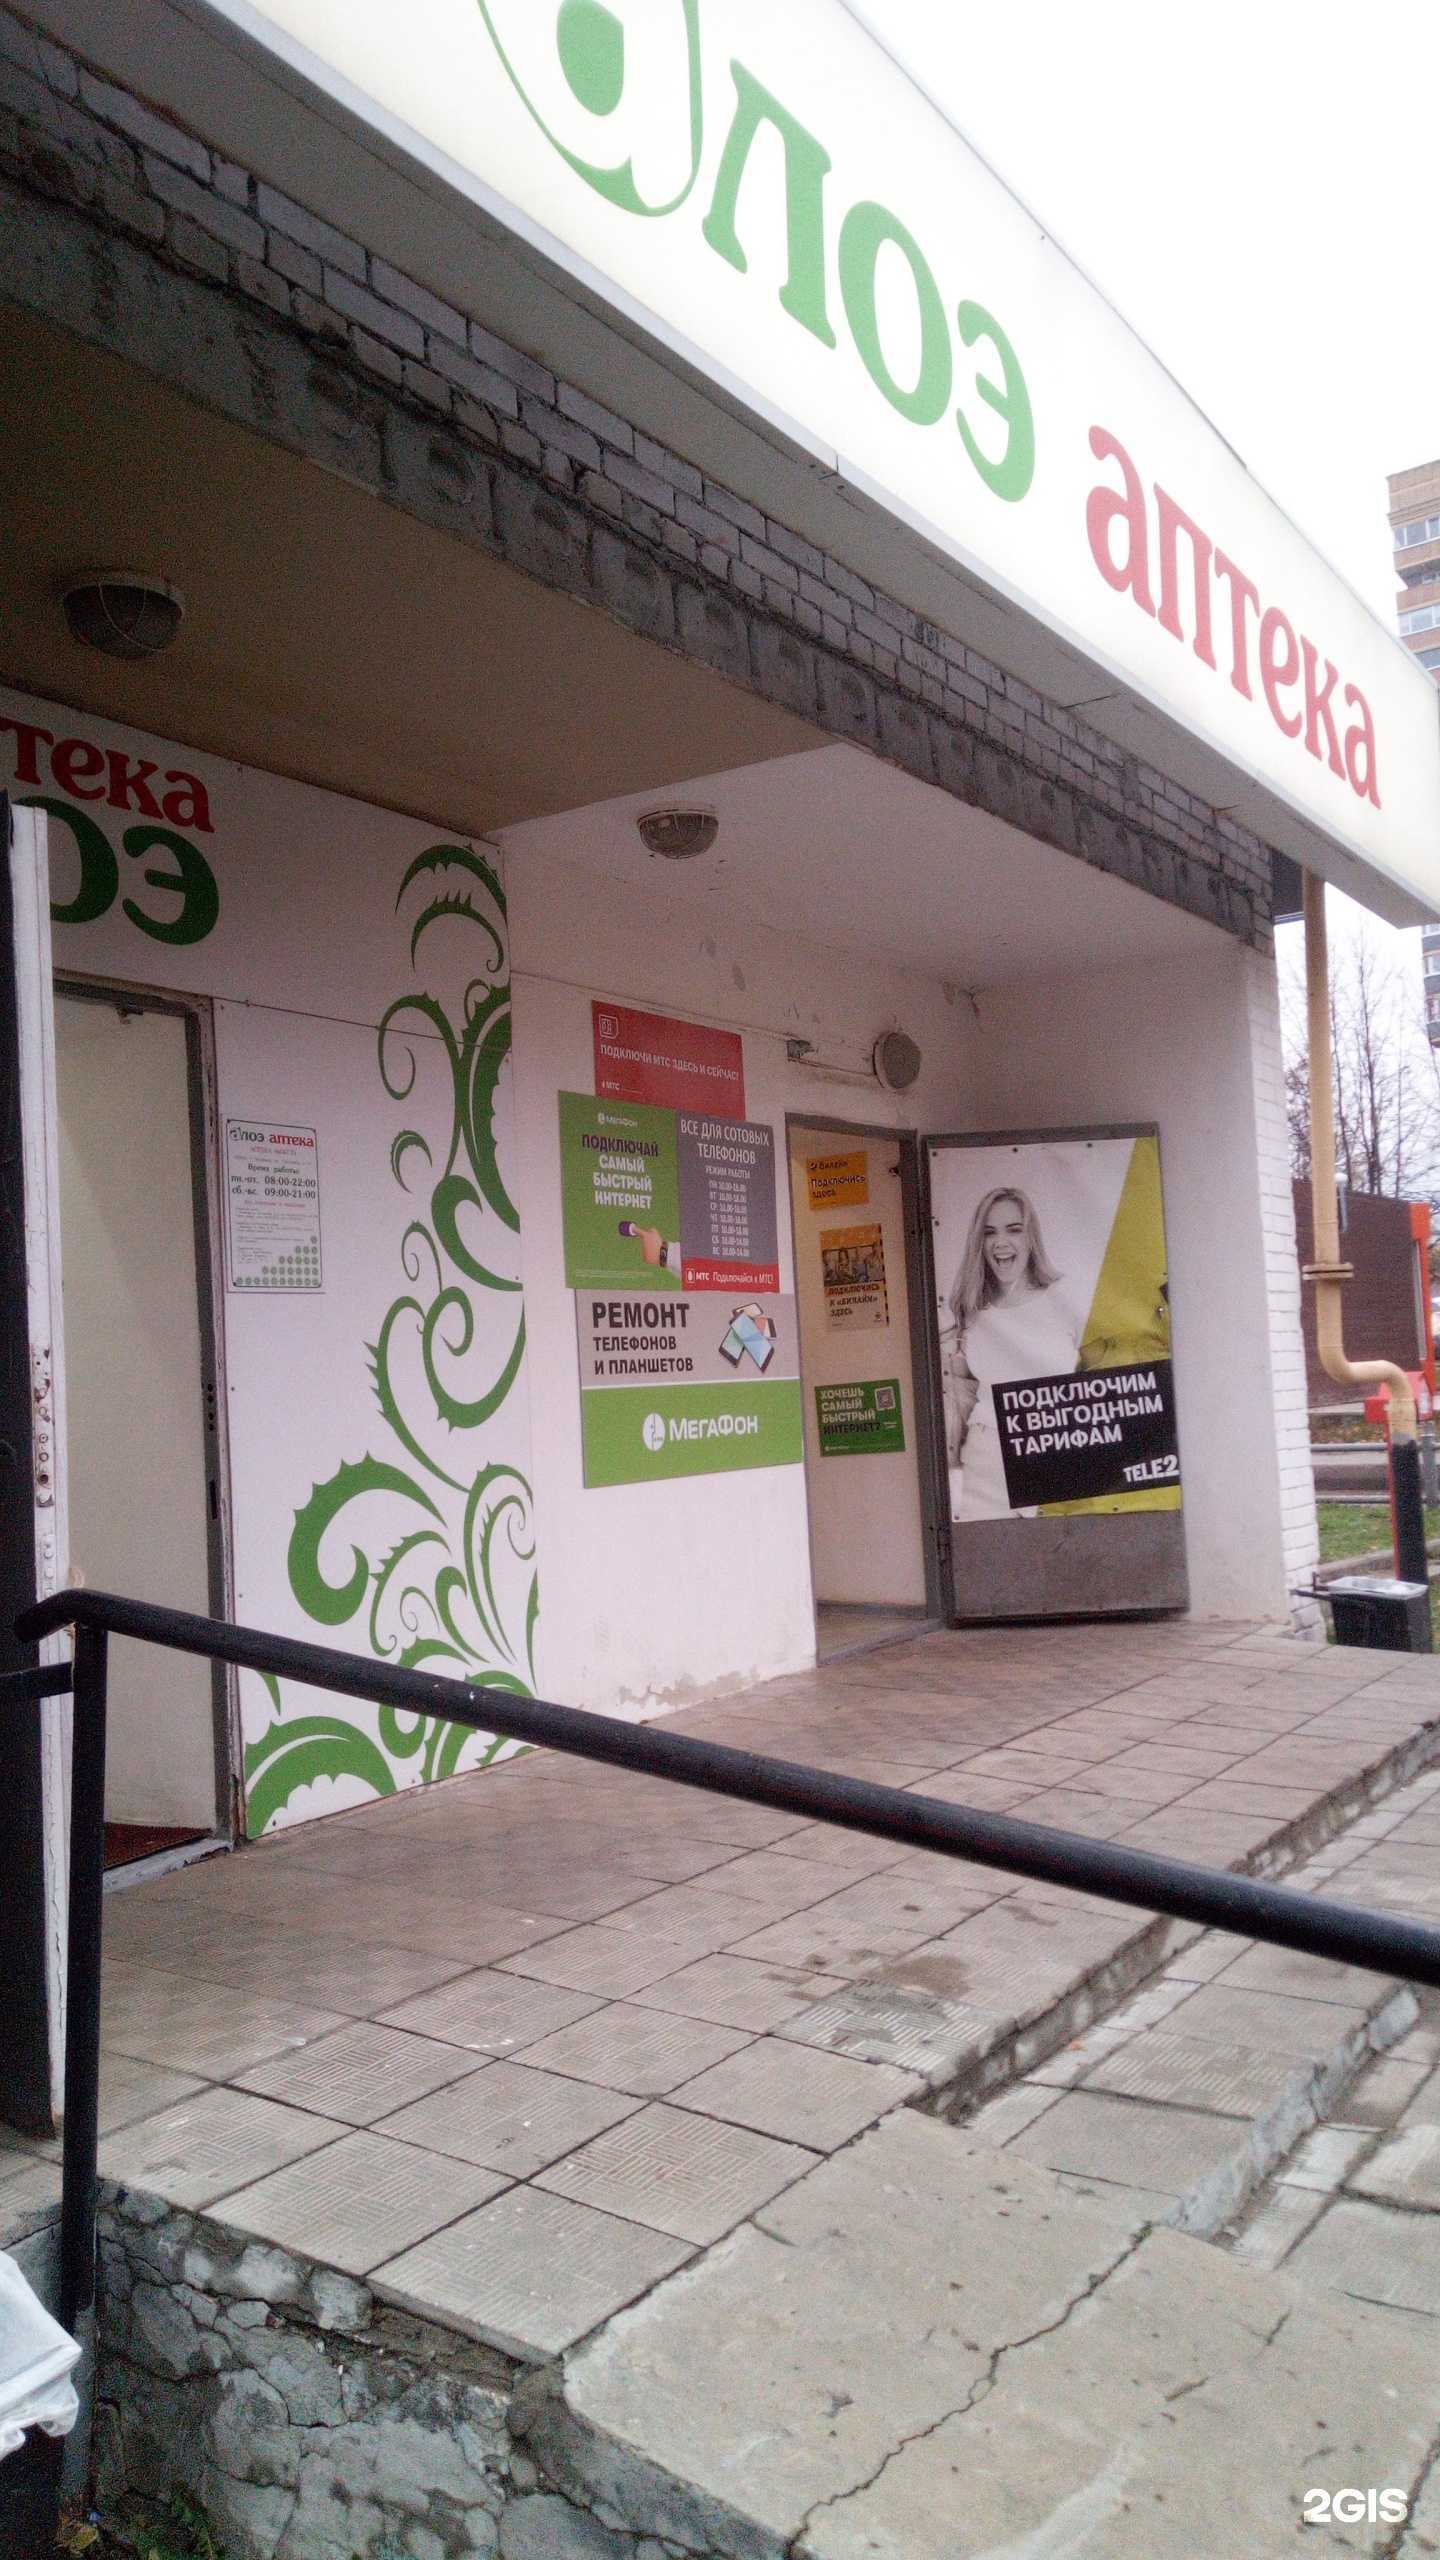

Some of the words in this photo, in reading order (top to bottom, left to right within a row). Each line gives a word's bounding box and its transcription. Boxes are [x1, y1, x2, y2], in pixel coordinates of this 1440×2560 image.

[1086, 424, 1382, 811] аптека
[600, 1044, 652, 1065] ПОДКЛЮЧИ
[653, 1055, 671, 1068] МТС
[672, 1058, 699, 1073] ЗДЕСЬ
[699, 1063, 706, 1073] И
[706, 1064, 739, 1081] СЕЙЧАС!
[269, 1134, 314, 1148] аптека
[680, 1119, 699, 1135] ВСЕ
[700, 1123, 722, 1141] ДЛЯ
[723, 1126, 770, 1147] СОТОВЫХ
[581, 1133, 659, 1157] ПОДКЛЮЧАЙ
[697, 1142, 756, 1165] ТЕЛЕФОНОВ
[599, 1154, 645, 1173] САМЫЙ
[705, 1165, 728, 1178] РЕЖИМ
[728, 1168, 751, 1180] РАБОТЫ
[265, 1175, 316, 1188] 08:00-22:00
[592, 1172, 653, 1193] БЫСТРЫЙ
[810, 1174, 866, 1189] Подключись
[265, 1188, 316, 1199] 09:00-21:00
[594, 1191, 652, 1210] ИНТЕРНЕТ
[696, 1272, 710, 1281] МТС
[592, 1302, 690, 1329] РЕМОНТ
[593, 1336, 677, 1352] ТЕЛЕФОНОВ
[594, 1360, 605, 1375] И
[608, 1357, 694, 1375] ПЛАНШЕТОВ
[820, 1387, 865, 1400] ХОЧЕШЬ
[1002, 1371, 1157, 1411] ПОДКЛЮЧИМ
[821, 1398, 863, 1412] САМЫЙ
[1006, 1414, 1022, 1434] К
[1026, 1394, 1163, 1431] ВЫГОДНЫМ
[822, 1408, 876, 1423] БЫСТРЫЙ
[823, 1422, 880, 1435] ИНТЕРНЕТ?
[1010, 1424, 1123, 1457] ТАРИФАМ
[1123, 1454, 1180, 1483] TELE2
